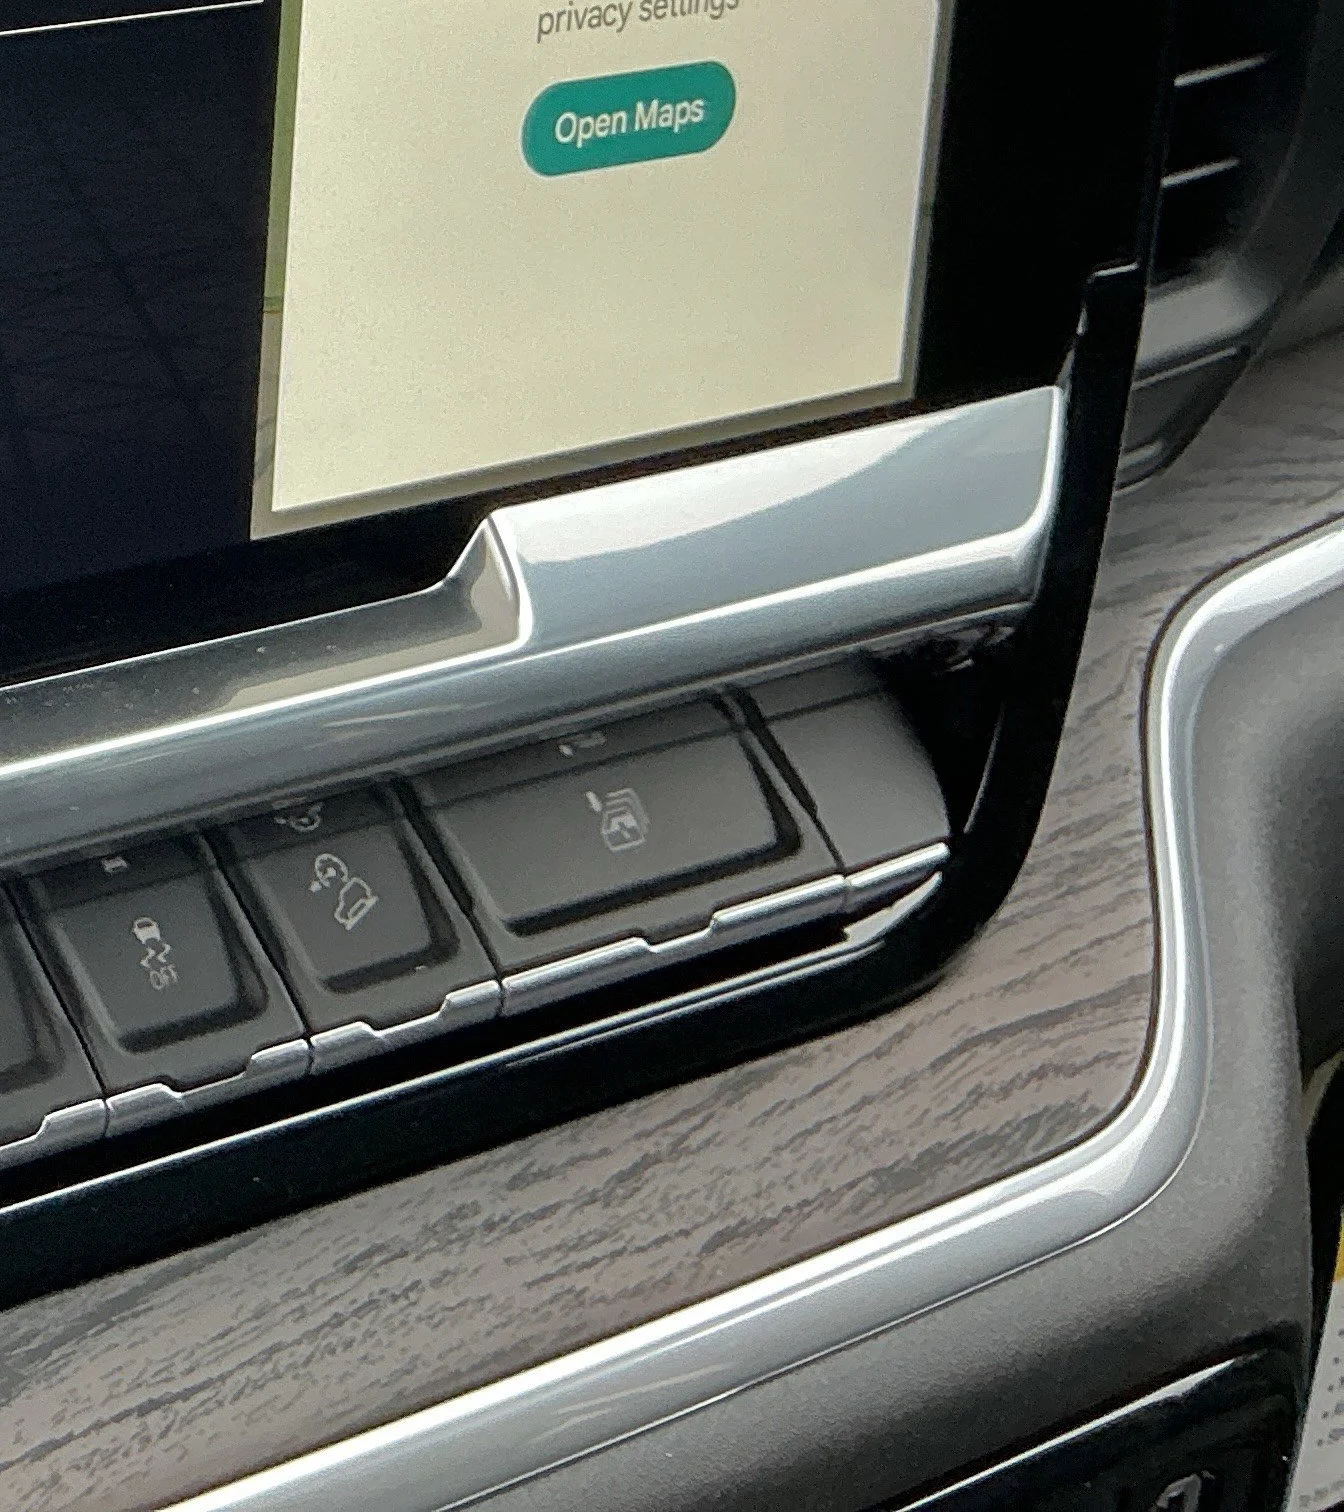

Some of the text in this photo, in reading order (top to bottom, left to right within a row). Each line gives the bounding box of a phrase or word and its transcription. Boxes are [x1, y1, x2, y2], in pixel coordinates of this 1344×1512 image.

[536, 0, 633, 43] privacy
[554, 97, 706, 148] Open Maps
